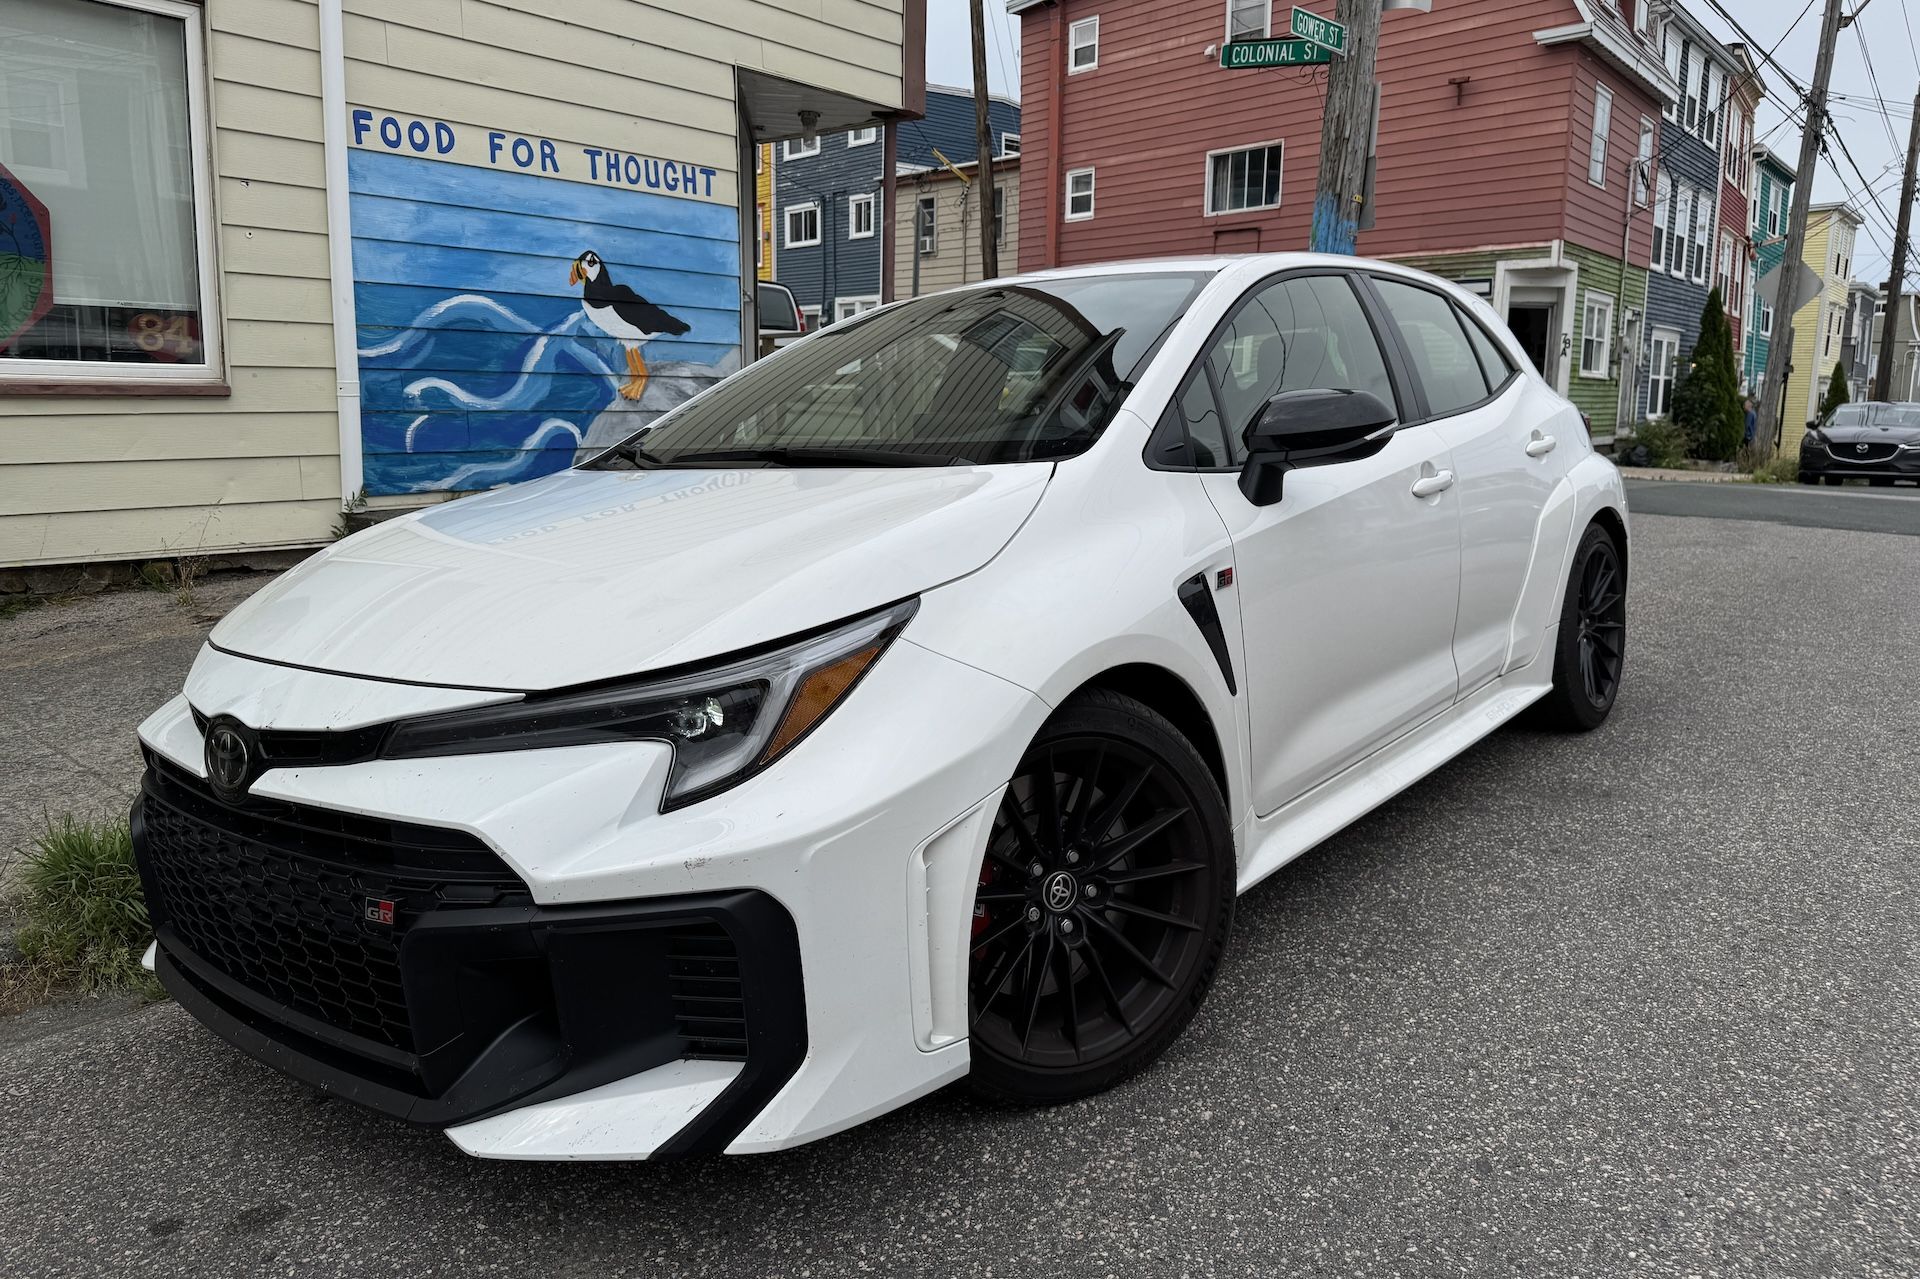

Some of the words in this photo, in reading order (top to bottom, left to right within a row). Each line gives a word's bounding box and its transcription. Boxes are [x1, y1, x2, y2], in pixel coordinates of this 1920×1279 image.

[1297, 13, 1325, 41] GOWER
[1328, 26, 1340, 46] ST
[1232, 43, 1296, 63] COLONIAL
[352, 109, 455, 154] FOOD
[488, 131, 560, 173] FOR
[583, 148, 717, 197] THOUGHT
[136, 312, 193, 353] 84
[366, 905, 393, 923] GR
